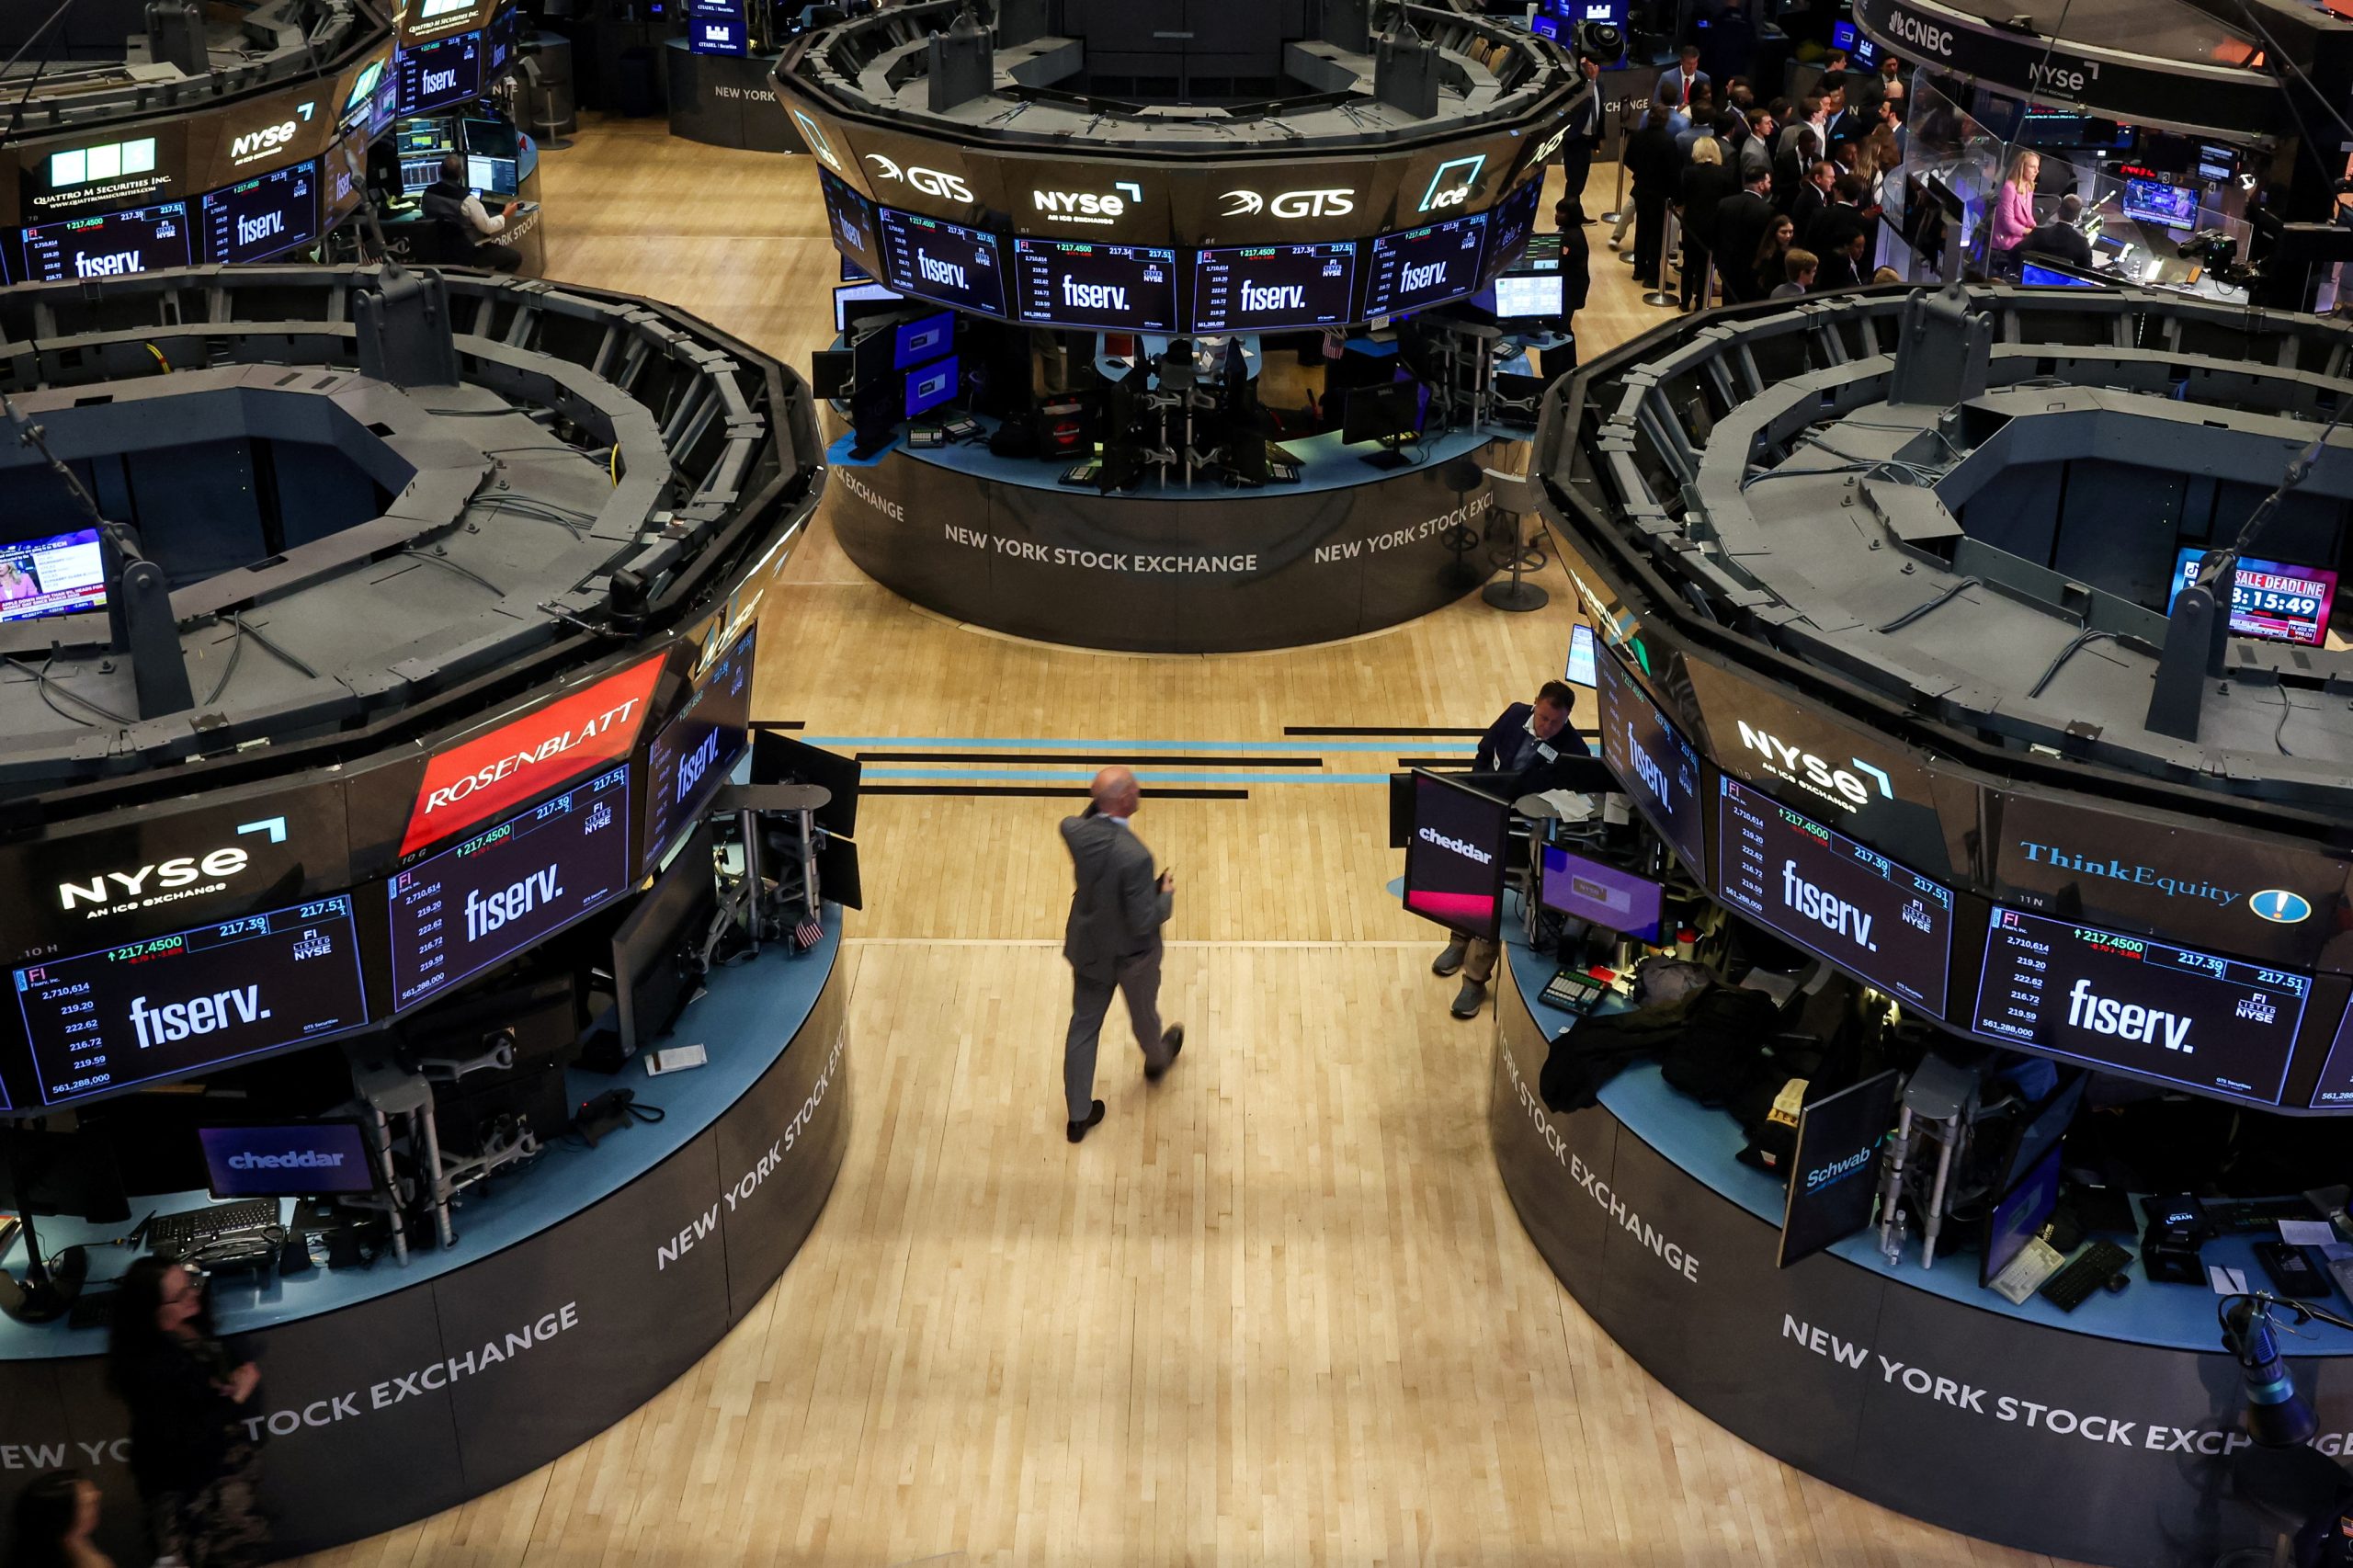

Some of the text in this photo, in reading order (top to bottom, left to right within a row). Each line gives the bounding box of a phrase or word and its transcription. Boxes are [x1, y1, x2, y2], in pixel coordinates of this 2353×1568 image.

[1905, 18, 1954, 56] CNBC
[423, 68, 456, 95] fiserv.
[715, 86, 776, 102] NEW YORK
[907, 167, 973, 203] GTS
[2163, 174, 2169, 183] 3
[2209, 184, 2215, 193] 4
[34, 191, 81, 205] QUATTRO
[97, 180, 148, 195] SECURITIES
[152, 176, 171, 185] INC.
[1270, 189, 1355, 218] GTS
[72, 204, 183, 230] 217.4500 217.51
[156, 230, 176, 239] NYSE
[237, 210, 284, 246] fiserv.
[492, 231, 512, 246] ORK
[1062, 244, 1092, 252] 217.4500
[1149, 250, 1172, 258] 217.51
[75, 250, 144, 278] fiserv.
[918, 248, 969, 290] fiserv.
[1400, 260, 1447, 293] fiserv.
[1063, 275, 1130, 310] fiserv.
[1241, 279, 1305, 311] fiserv.
[847, 472, 904, 522] EXCHANGE
[1314, 540, 1362, 563] NEW
[1367, 527, 1415, 552] YORK
[1419, 503, 1467, 540] STOCK
[946, 523, 1257, 575] NEW YORK STOCK EXCHANGE
[2235, 571, 2323, 597] SALE DEADLINE
[424, 697, 640, 813] ROSENBLATT
[676, 725, 719, 804] fiserv.
[1628, 721, 1673, 814] fiserv.
[1762, 761, 1777, 774] AN
[464, 769, 625, 856] 217.4500 217.39 217.51
[594, 801, 603, 813] FI
[1733, 806, 1763, 827] 2,710,614
[585, 816, 610, 835] NYSE
[1743, 828, 1763, 844] 219.20
[1418, 826, 1493, 866] cheddar
[1729, 782, 1739, 797] FI
[1785, 812, 1828, 841] 217.4500
[1854, 847, 1888, 869] 217.39
[1914, 878, 1948, 902] 217.51
[1742, 846, 1763, 861] 222.62
[2020, 840, 2243, 907] ThinkEquity
[405, 882, 441, 905] 2,710,614
[464, 863, 563, 943] fiserv.
[2033, 898, 2043, 906] N
[86, 906, 108, 919] AN
[417, 900, 442, 917] 219.20
[1782, 859, 1877, 952] fiserv.
[418, 918, 442, 936] 222.62
[1903, 912, 1931, 934] NYSE
[28, 968, 46, 982] FI
[118, 937, 182, 960] 217.4500
[220, 917, 266, 937] 217.39
[300, 899, 346, 918] 217.51
[293, 937, 330, 950] LISTED
[303, 929, 317, 939] FI
[2007, 937, 2050, 952] 2,710,614
[47, 944, 58, 953] H
[294, 945, 331, 960] NYSE
[419, 937, 443, 954] 216.72
[2004, 912, 2302, 989] FI 217.4500 217.39 217.51
[420, 954, 444, 972] 219.59
[2017, 956, 2046, 970] 219.20
[402, 971, 445, 1000] 561,288,000
[2014, 973, 2043, 987] 222.62
[42, 983, 90, 1000] 2,710,614
[2010, 991, 2040, 1004] 216.72
[2252, 993, 2267, 1004] FI
[61, 1001, 94, 1015] 219.20
[129, 984, 271, 1049] fiserv.
[2008, 1007, 2037, 1020] 219.59
[2068, 978, 2194, 1054] fiserv.
[2235, 1007, 2274, 1024] NYSE
[2238, 1001, 2276, 1014] LISTED
[65, 1019, 97, 1033] 222.62
[1983, 1018, 2033, 1038] 561,288,000
[70, 1038, 102, 1051] 216.72
[74, 1055, 106, 1070] 219.59
[52, 1074, 110, 1094] 561,288,000
[228, 1150, 344, 1170] cheddar
[657, 1202, 719, 1271] NEW
[724, 1140, 781, 1211] YORK
[785, 1066, 828, 1152] STOCK
[1806, 1147, 1870, 1187] Schwab
[1520, 1081, 1567, 1167] STOCK
[1571, 1153, 1699, 1283] EXCHANGE
[0, 1301, 580, 1471] EW YO TOCK EXCHANGE
[1782, 1313, 1869, 1370] NEW
[1878, 1355, 1989, 1415] YORK
[1995, 1395, 2136, 1447] STOCK
